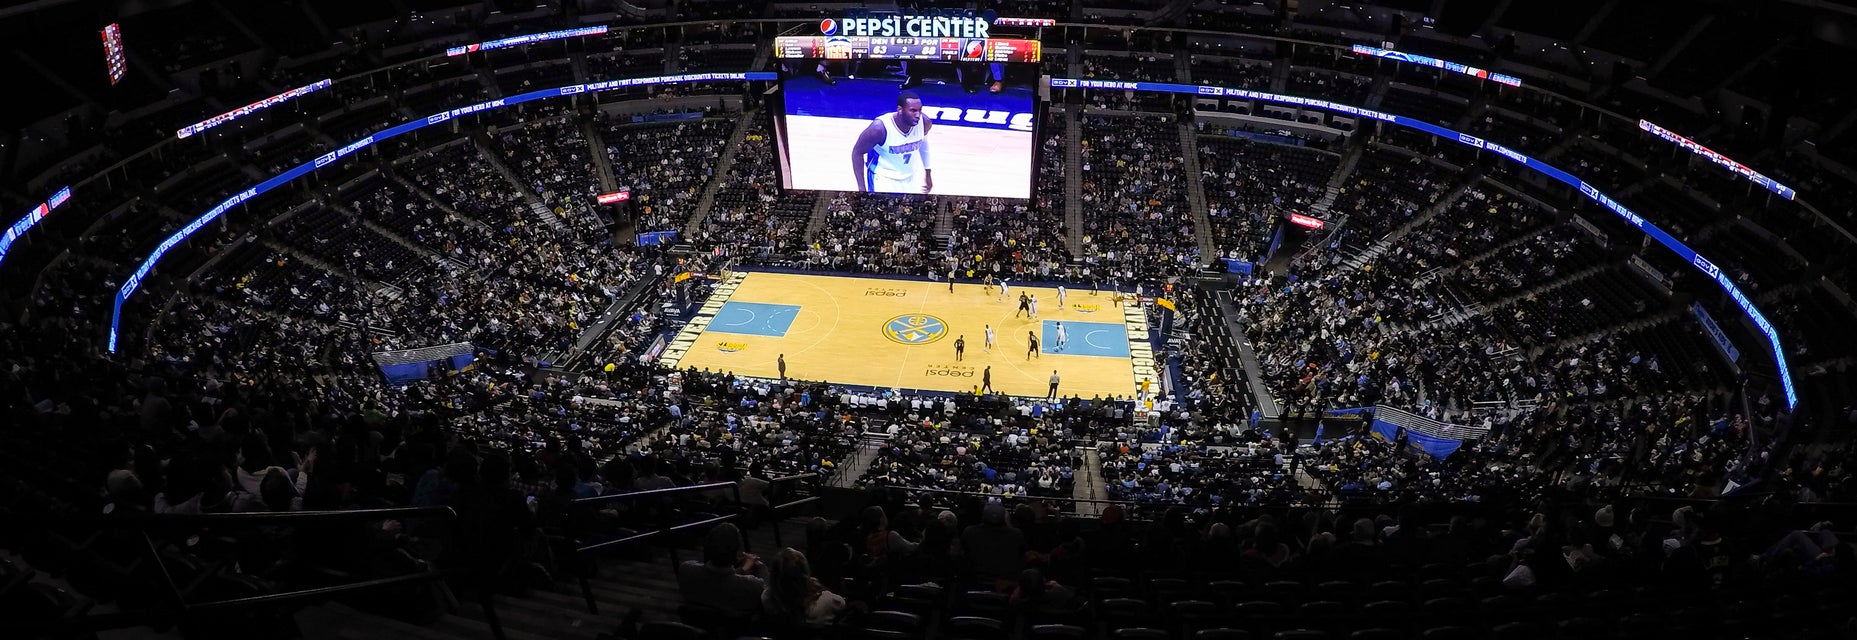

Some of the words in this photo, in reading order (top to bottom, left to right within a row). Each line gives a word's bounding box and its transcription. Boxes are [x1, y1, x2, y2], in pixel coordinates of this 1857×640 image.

[842, 18, 901, 36] PEPSI
[906, 18, 990, 38] CENTER
[873, 46, 888, 54] 63
[921, 46, 937, 55] 88
[587, 82, 608, 91] MILITARY
[632, 77, 660, 85] RESPONDERS
[661, 75, 683, 83] PURCHASE
[684, 73, 711, 81] DISCOUNTED
[712, 72, 729, 80] TICKETS
[730, 72, 746, 80] ONLINE
[452, 109, 461, 117] FOR
[461, 106, 473, 115] YOUR
[1226, 88, 1248, 97] MILITARY
[1259, 92, 1273, 100] FIRST
[1274, 94, 1304, 104] RESPONDERS
[1305, 98, 1328, 108] PURCHASE
[1329, 102, 1358, 114] DISCOUNTED
[1358, 108, 1378, 118] TICKETS
[1378, 112, 1396, 122] ONLINE
[903, 153, 912, 164] 7
[239, 187, 257, 201] ONLINE
[1695, 257, 1718, 277] GOVX
[925, 368, 975, 378] pepsi
